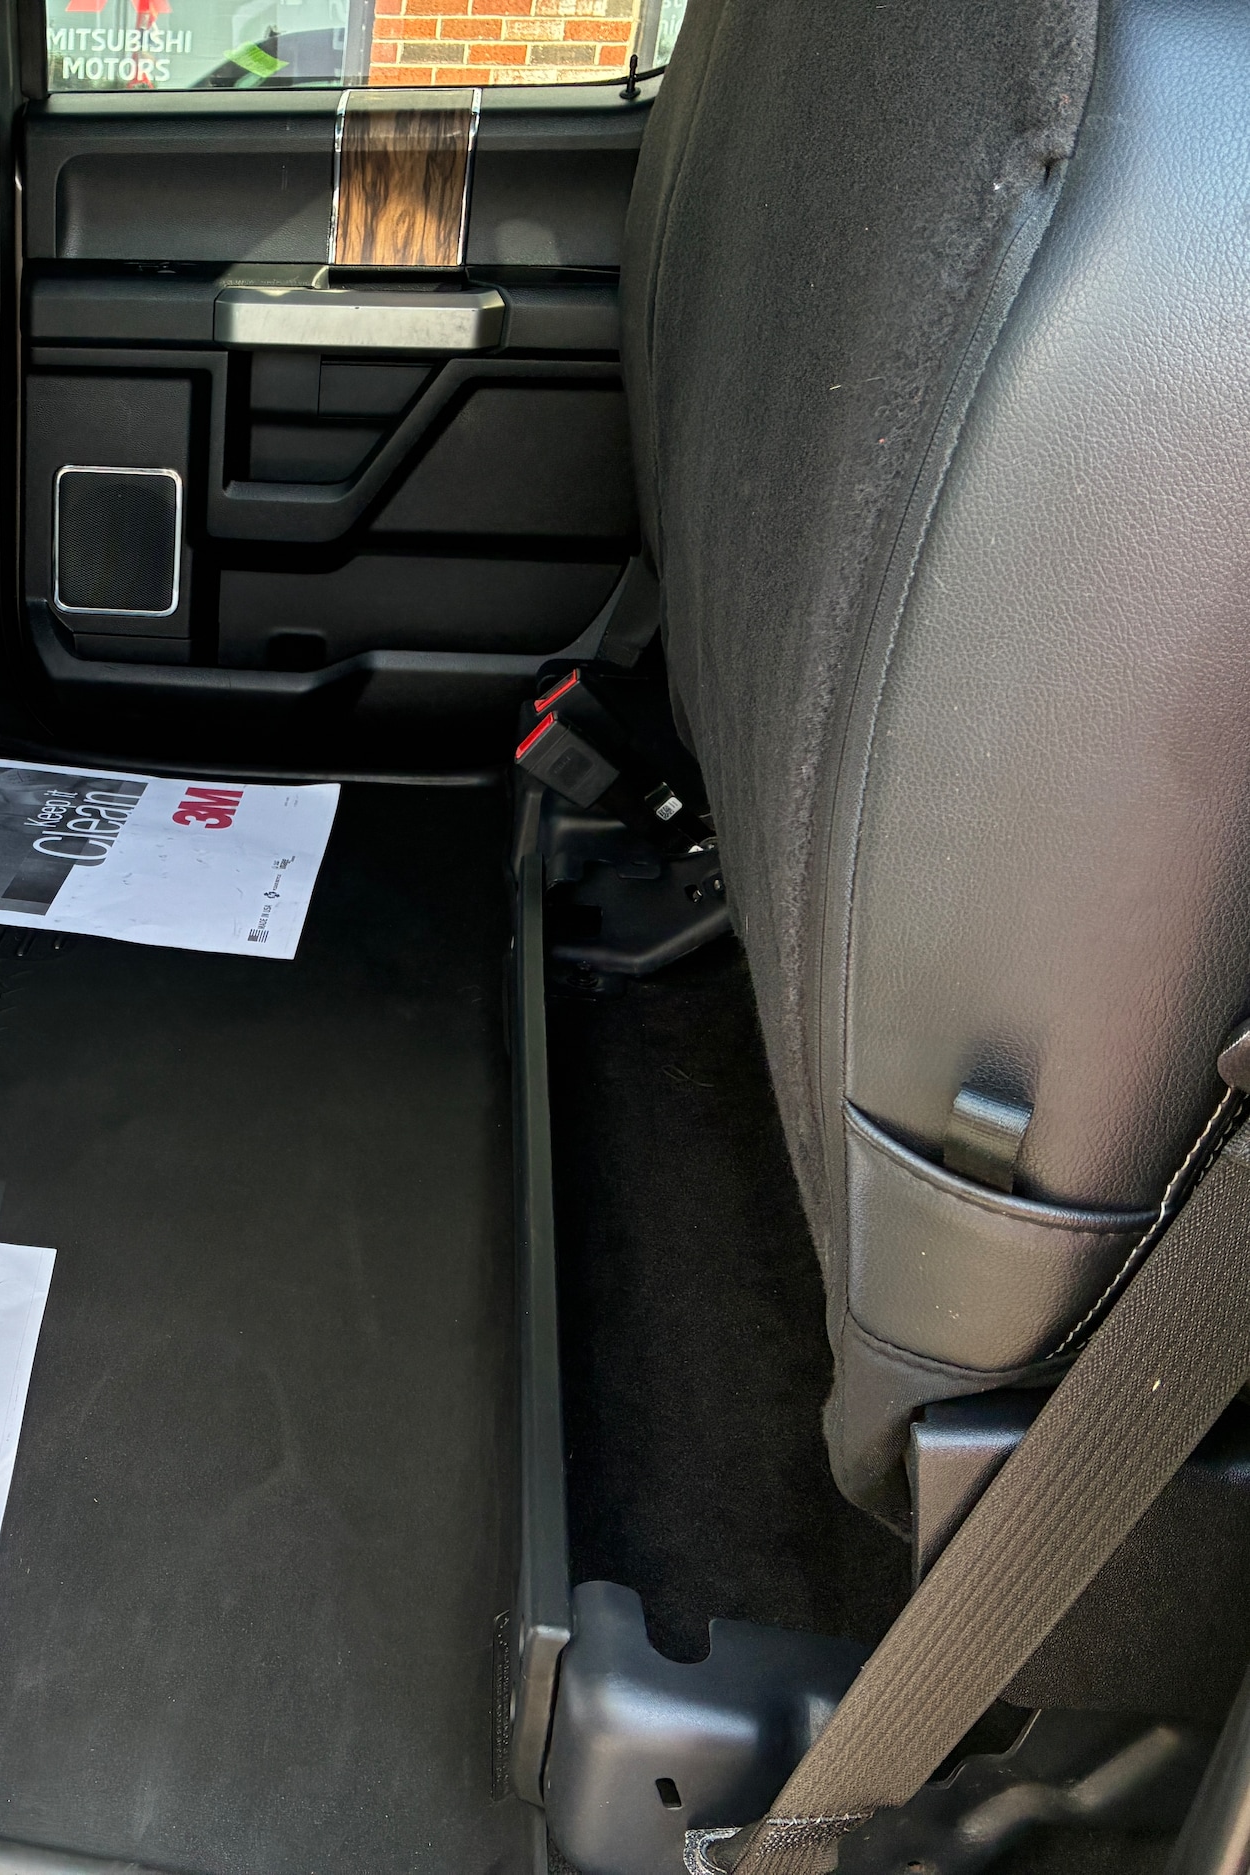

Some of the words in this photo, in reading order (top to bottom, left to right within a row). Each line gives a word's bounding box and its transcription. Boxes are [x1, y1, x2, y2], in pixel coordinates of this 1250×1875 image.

[47, 28, 192, 53] MITSUBISHI
[62, 57, 171, 82] MOTORS
[44, 789, 79, 800] it
[24, 799, 76, 828] Keep
[172, 787, 244, 829] 3M
[32, 791, 141, 860] Clean
[257, 917, 268, 930] MADE
[263, 904, 272, 913] USA
